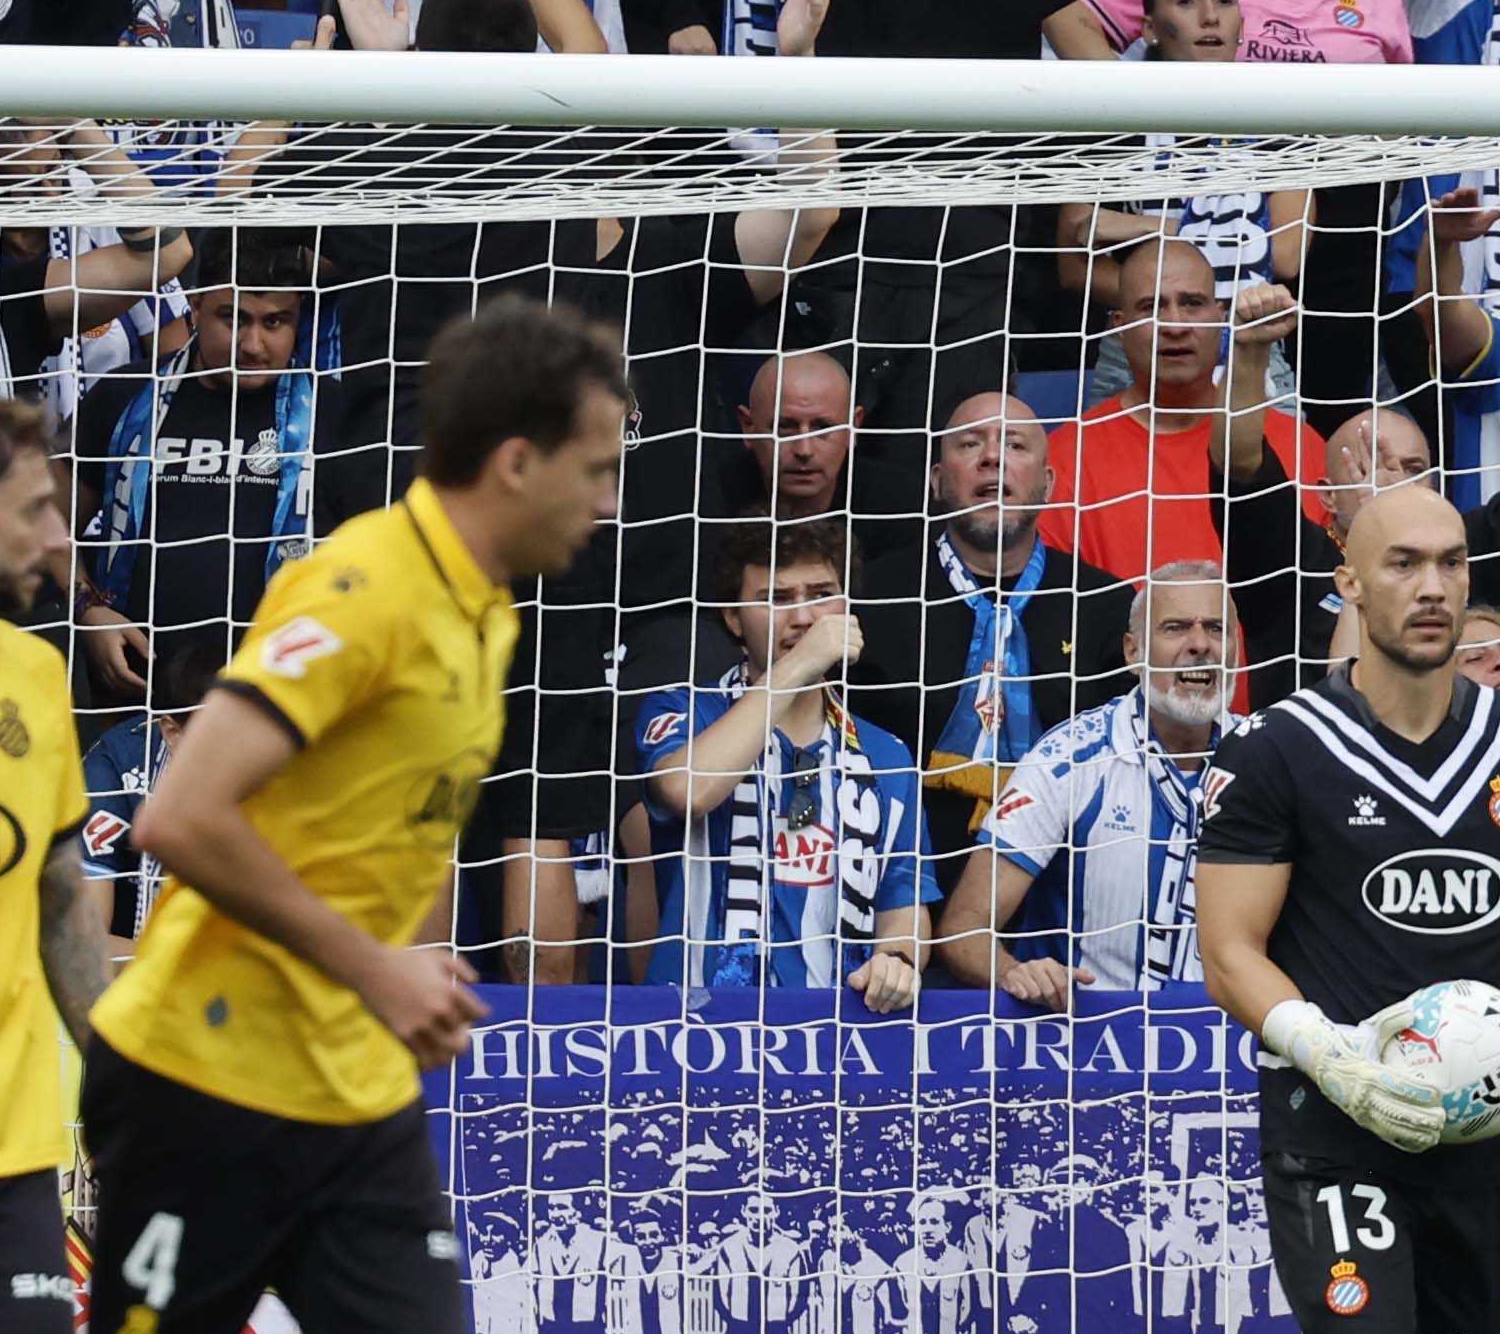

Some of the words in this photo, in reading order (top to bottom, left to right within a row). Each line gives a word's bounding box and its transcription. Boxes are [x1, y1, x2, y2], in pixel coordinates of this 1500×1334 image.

[1246, 40, 1328, 63] RIVIERA
[155, 438, 245, 476] FBI
[1347, 816, 1388, 827] KELME
[1379, 865, 1494, 916] DANI
[464, 1011, 888, 1081] HISTÒRIA
[1316, 1182, 1396, 1254] 13
[121, 1210, 186, 1311] 4
